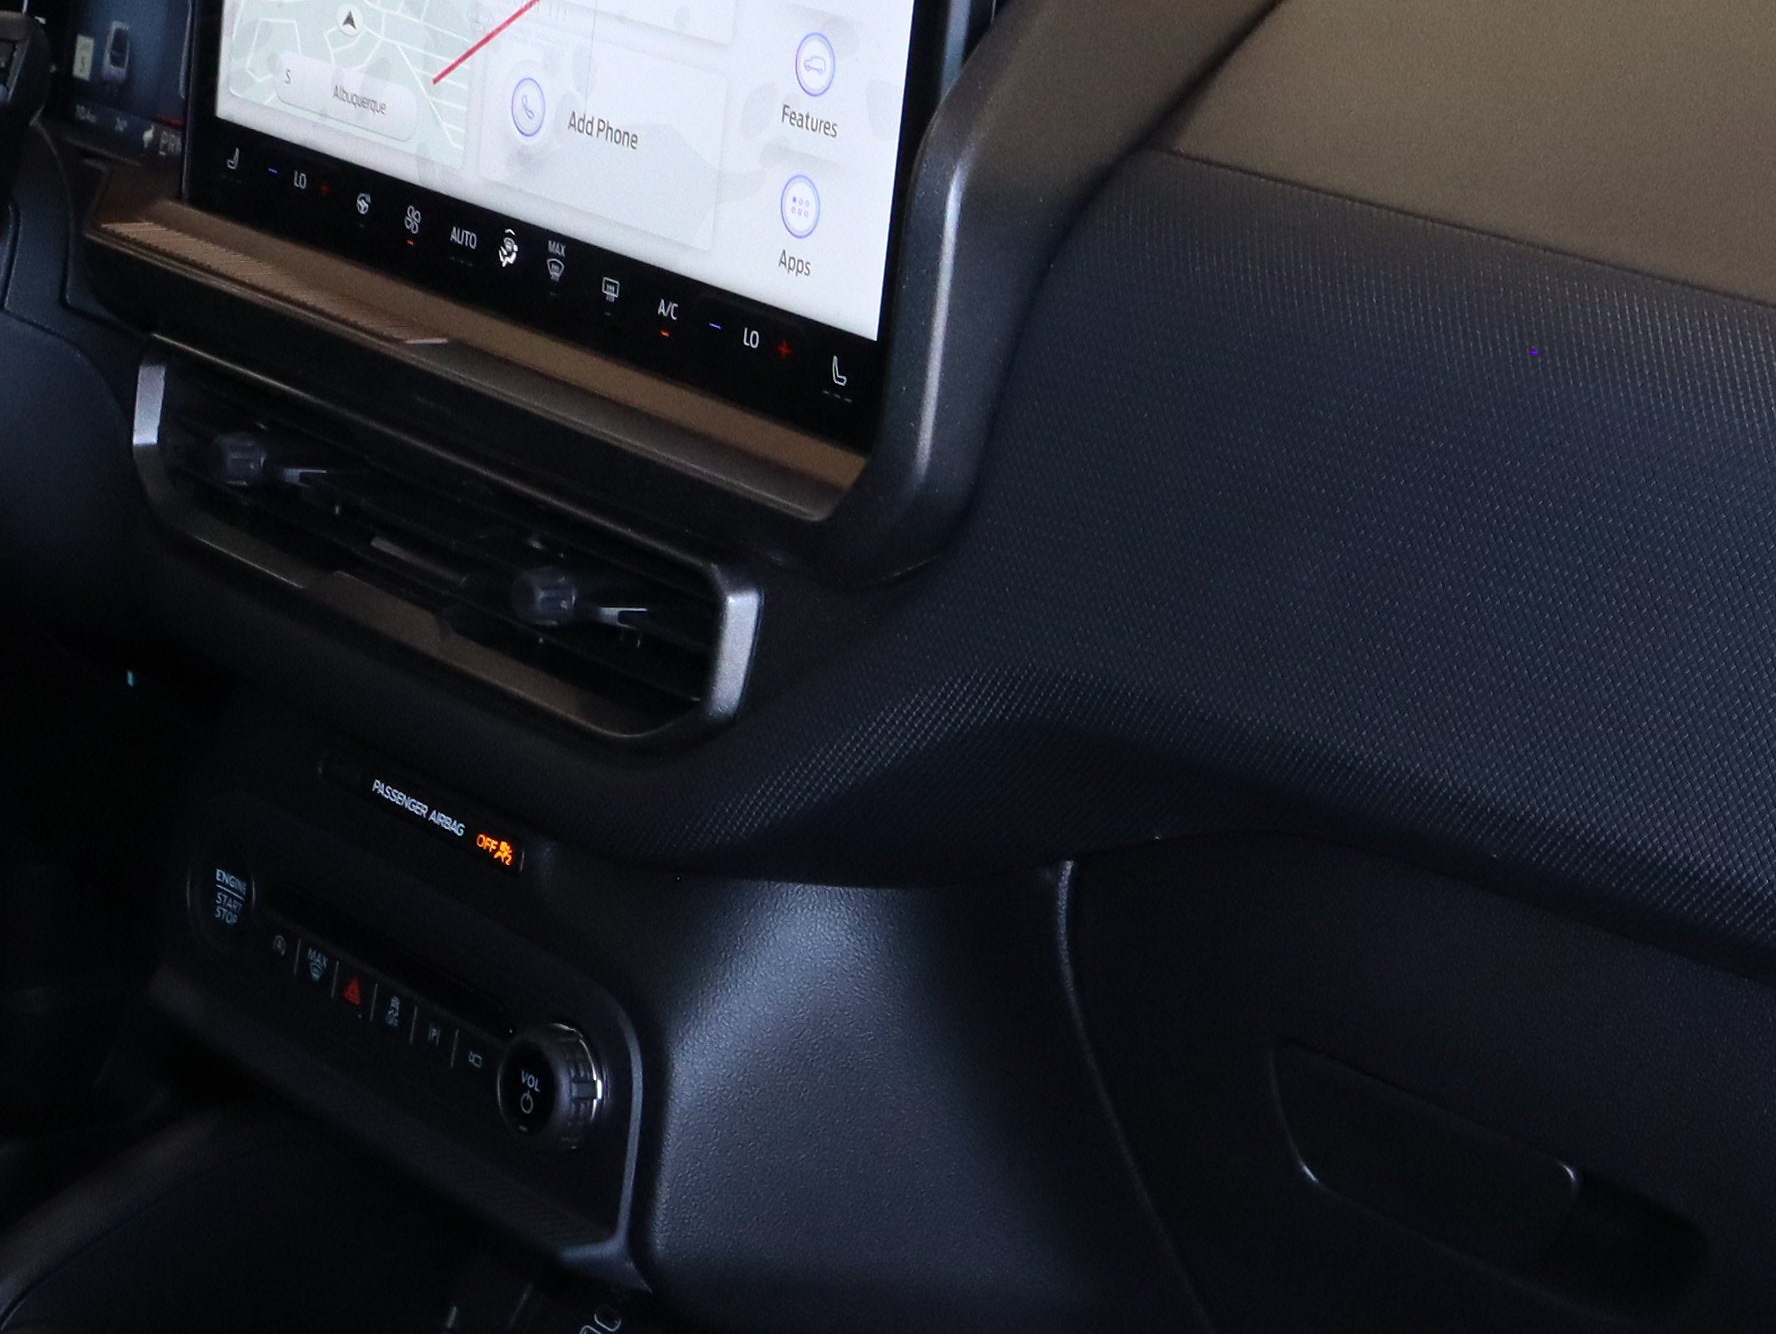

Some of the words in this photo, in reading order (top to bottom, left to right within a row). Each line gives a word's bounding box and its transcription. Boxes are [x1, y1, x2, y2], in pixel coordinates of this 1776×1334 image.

[284, 69, 292, 84] S
[332, 84, 389, 117] Albuquerque
[568, 110, 594, 137] Add
[595, 118, 639, 151] Phone
[780, 104, 839, 139] Features
[293, 169, 308, 190] LO
[450, 225, 478, 251] AUTO
[547, 239, 567, 259] MAX
[777, 248, 812, 278] Apps
[657, 298, 679, 321] A/C
[742, 326, 761, 349] LO
[371, 778, 429, 819] PASSENGER
[427, 808, 466, 838] AIRBAG
[475, 833, 499, 854] OFF
[215, 867, 247, 896] ENGINE
[215, 891, 243, 913] START
[215, 906, 239, 925] STOP
[521, 1069, 541, 1093] VOL
